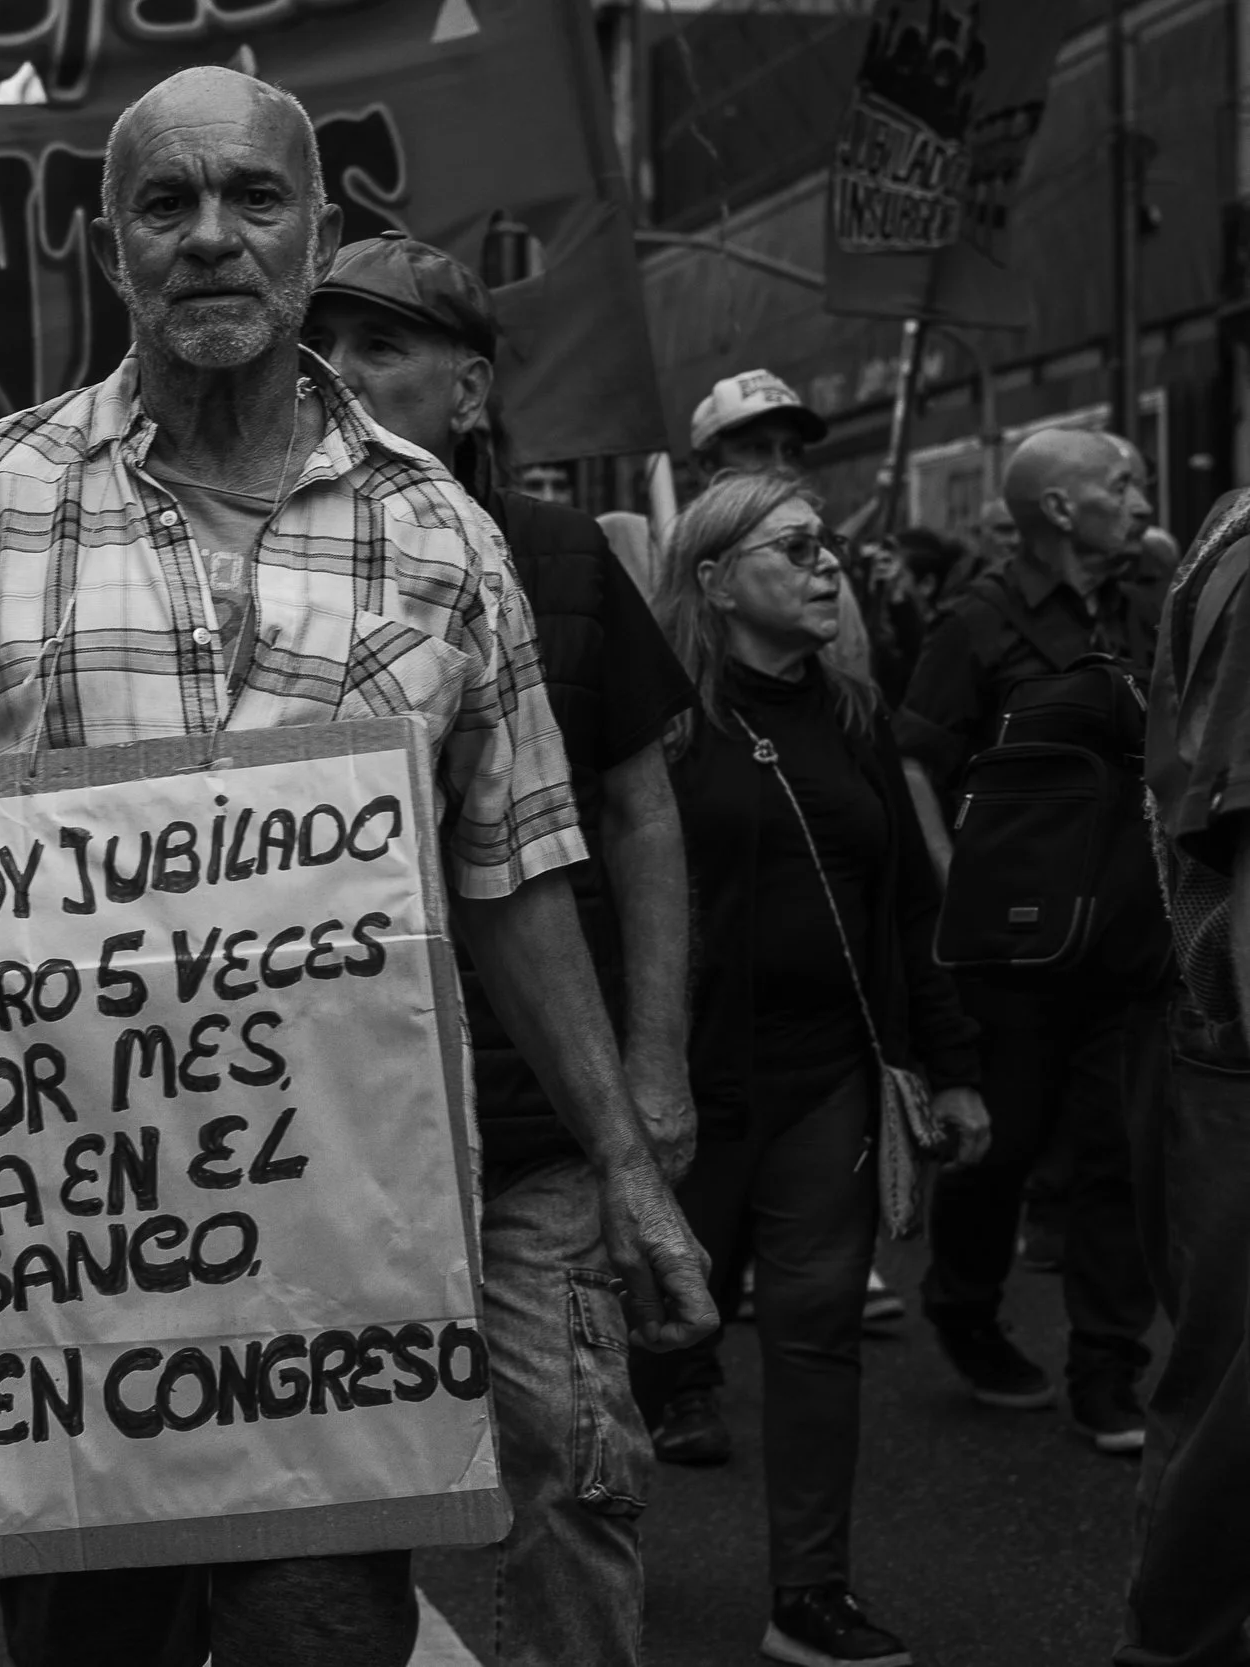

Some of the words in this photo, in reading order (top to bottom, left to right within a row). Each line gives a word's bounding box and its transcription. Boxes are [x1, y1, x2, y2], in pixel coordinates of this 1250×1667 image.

[60, 794, 402, 915] JUBILADO
[97, 930, 148, 1016] 5
[173, 912, 392, 1003] VECES
[60, 1126, 160, 1216] EN
[187, 1108, 309, 1190] EL
[103, 1321, 489, 1440] CONGRESO
